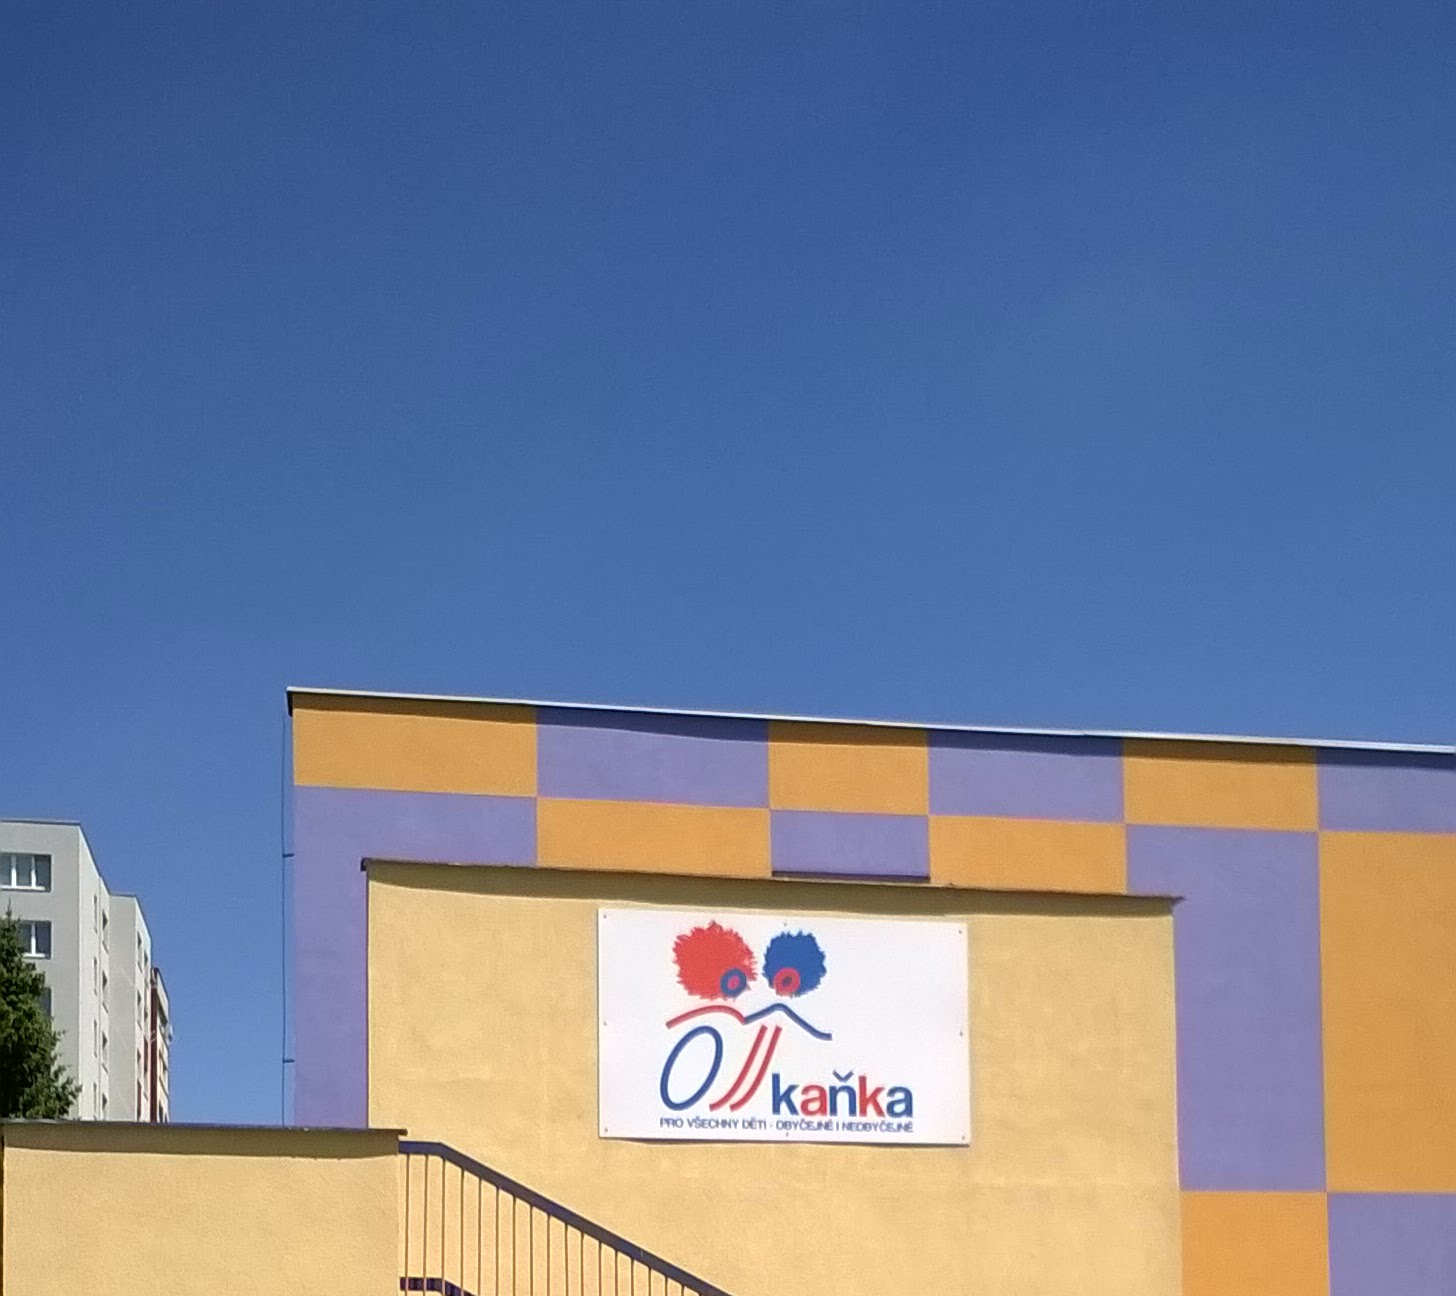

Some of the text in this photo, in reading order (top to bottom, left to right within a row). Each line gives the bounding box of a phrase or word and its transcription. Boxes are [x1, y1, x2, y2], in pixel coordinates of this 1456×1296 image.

[772, 1070, 913, 1117] kaňka
[660, 1117, 683, 1129] PRO
[688, 1115, 739, 1130] VŠECHNY
[742, 1116, 767, 1130] DĚTI
[776, 1118, 834, 1131] OBYČEJNÉ
